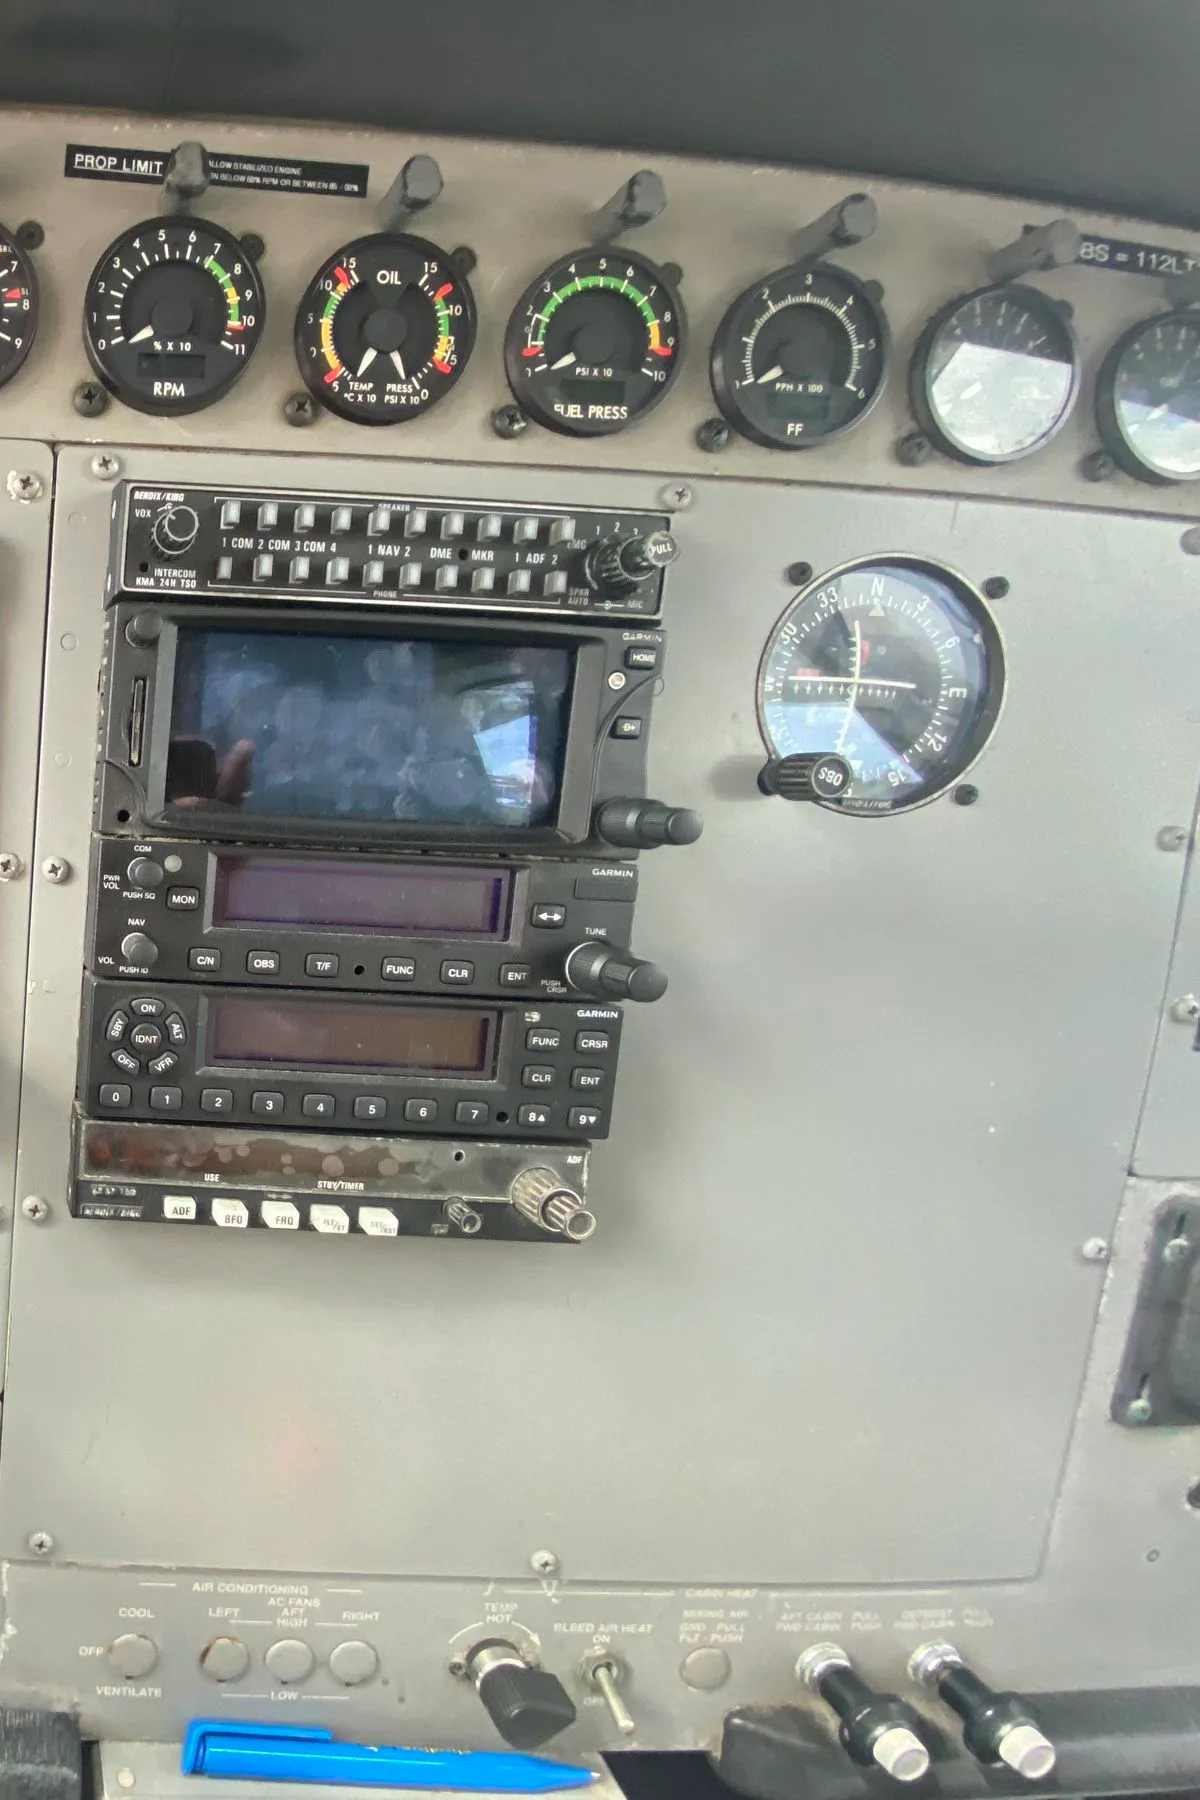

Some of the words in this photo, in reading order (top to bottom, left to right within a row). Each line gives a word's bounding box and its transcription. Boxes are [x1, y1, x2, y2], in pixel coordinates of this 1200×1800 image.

[75, 154, 117, 169] PROP
[122, 158, 163, 174] LIMIT
[376, 270, 401, 285] OIL
[153, 382, 185, 397] RPM
[349, 382, 374, 391] TEMP
[386, 384, 413, 393] PRESS
[588, 405, 628, 419] PRESS
[787, 423, 803, 436] FF
[135, 509, 151, 518] VOX
[231, 538, 253, 549] COM
[258, 539, 263, 550] 2
[268, 540, 290, 551] COM
[295, 540, 300, 551] 3
[303, 541, 325, 553] COM
[330, 542, 337, 553] 4
[377, 545, 399, 556] NAV
[404, 546, 410, 557] 2
[430, 548, 452, 559] DME
[471, 550, 493, 561] MKR
[526, 553, 545, 565] ADF
[552, 554, 558, 565] 2
[154, 568, 196, 578] INTERCOM
[135, 578, 154, 587] KMA
[180, 579, 197, 588] TSO
[622, 632, 662, 642] GARMIN
[633, 653, 656, 663] HOME
[817, 767, 844, 787] OBS
[134, 845, 152, 853] COM
[103, 874, 120, 882] PWR
[592, 868, 634, 878] GARMIN
[103, 881, 120, 890] VOL
[122, 891, 142, 899] PUSH
[144, 892, 156, 900] SQ
[171, 895, 195, 904] MON
[128, 918, 146, 927] NAV
[585, 927, 607, 936] TUNE
[98, 956, 115, 965] VOL
[197, 956, 215, 966] C/N
[253, 959, 275, 969] OBS
[316, 961, 331, 971] T/F
[386, 965, 414, 975] FUNC
[448, 968, 468, 978] CLR
[507, 971, 527, 981] ENT
[119, 966, 139, 974] PUSH
[140, 1003, 156, 1013] ON
[577, 1009, 618, 1019] GARMIN
[111, 1017, 125, 1037] SBY
[171, 1023, 183, 1040] ALT
[135, 1034, 158, 1044] IDNT
[532, 1036, 559, 1047] FUNC
[581, 1038, 608, 1049] CRSR
[117, 1054, 135, 1070] OFF
[155, 1057, 174, 1073] VFR
[532, 1073, 552, 1083] CLR
[580, 1076, 600, 1086] ENT
[567, 1155, 583, 1165] ADF
[204, 1173, 220, 1182] USE
[317, 1180, 365, 1191] STBY/TIMER
[172, 1206, 191, 1216] ADF
[192, 1582, 213, 1592] AIR
[217, 1582, 308, 1595] CONDITIONING
[268, 1597, 285, 1607] AC
[288, 1598, 320, 1608] FANS
[119, 1607, 154, 1618] COOL
[208, 1608, 240, 1617] LEFT
[342, 1611, 381, 1621] RIGHT
[78, 1646, 104, 1656] OFF
[96, 1686, 162, 1697] VENTILATE
[270, 1691, 298, 1700] LOW
